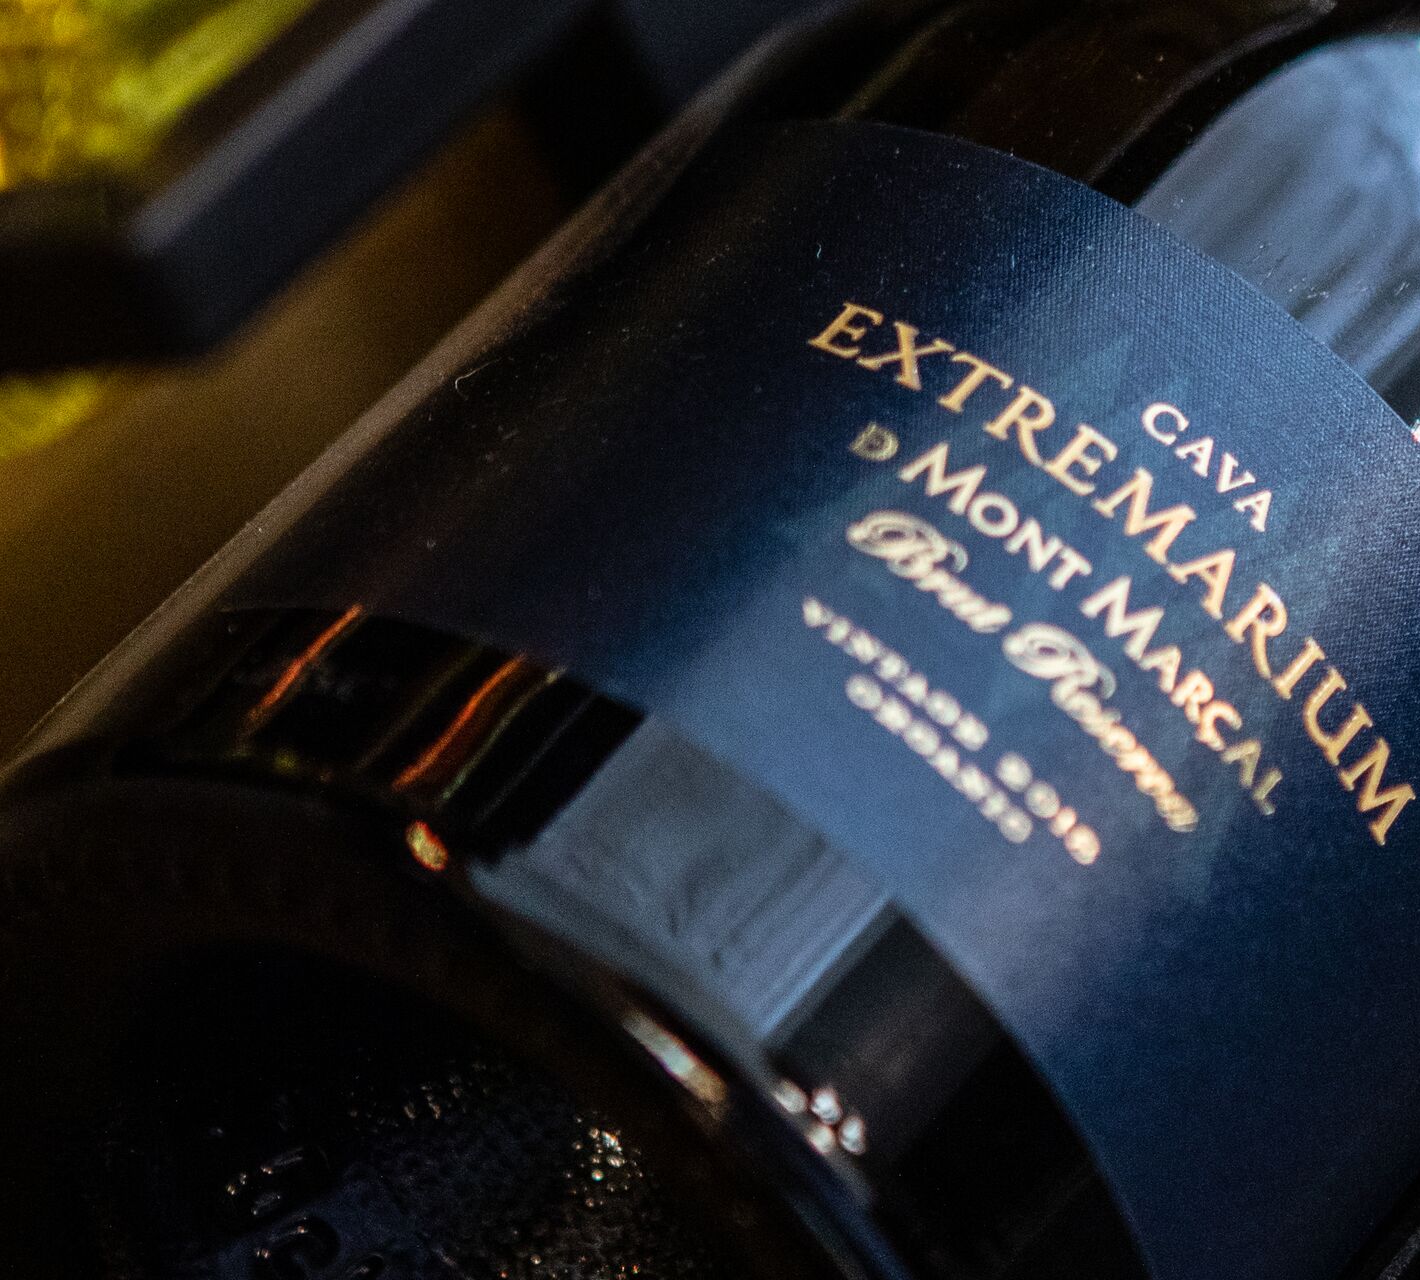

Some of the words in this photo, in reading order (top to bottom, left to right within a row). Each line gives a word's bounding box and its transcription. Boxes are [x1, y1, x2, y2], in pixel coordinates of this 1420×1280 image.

[899, 442, 1093, 590] MONT
[1140, 402, 1274, 532] CAVA
[808, 301, 1416, 846] EXTREMARIUM
